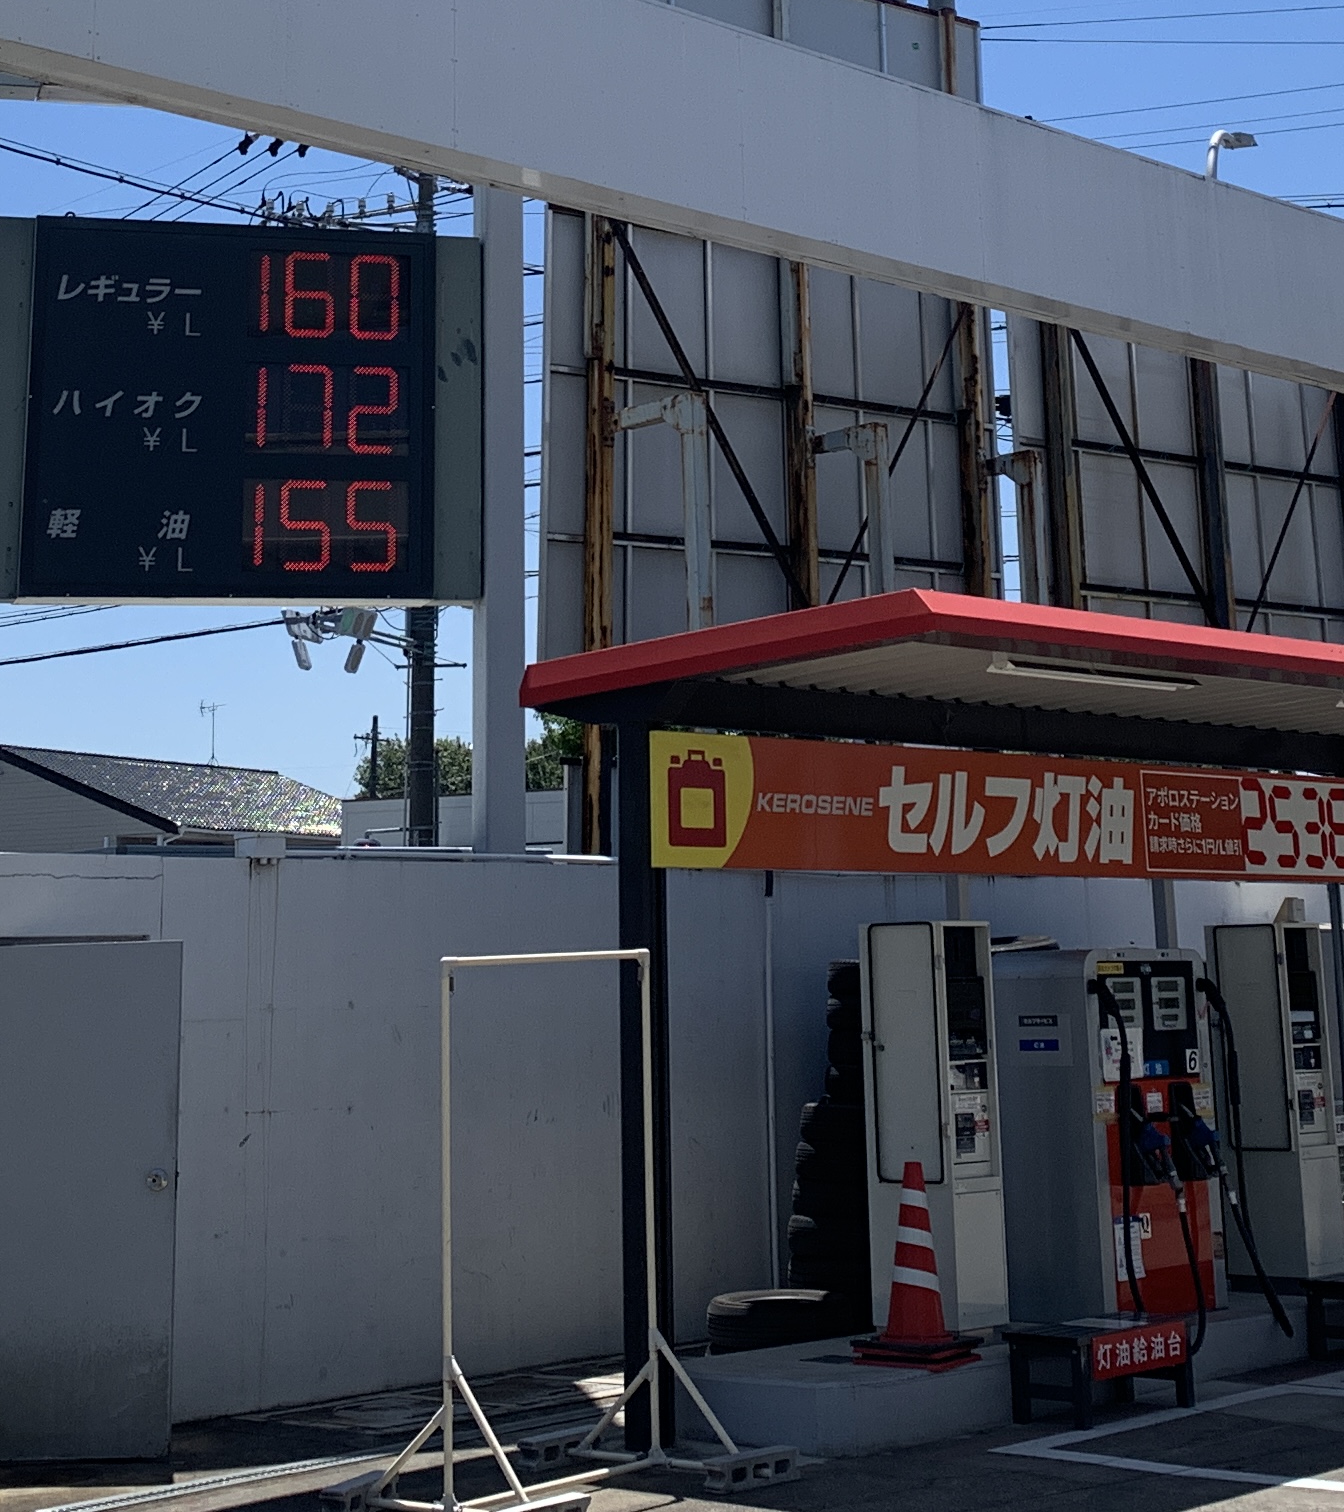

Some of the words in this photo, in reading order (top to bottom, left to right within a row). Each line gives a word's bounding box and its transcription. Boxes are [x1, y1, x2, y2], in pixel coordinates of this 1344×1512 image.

[56, 274, 202, 304] レギュラー
[259, 251, 400, 341] 160
[146, 311, 166, 335] ¥
[185, 312, 202, 336] L
[52, 389, 203, 419] ハイオク
[257, 363, 400, 455] 172
[143, 427, 162, 452] ¥
[181, 428, 198, 453] L
[253, 479, 397, 572] 155
[138, 546, 157, 571] ¥
[177, 546, 193, 572] L
[756, 792, 874, 818] KEROSENE
[1146, 786, 1239, 810] アポロステーション
[879, 764, 1134, 865] セルフ灯油
[1148, 810, 1203, 833] カード価格
[1188, 1051, 1197, 1071] 6
[1097, 1330, 1181, 1371] 灯油給油台
